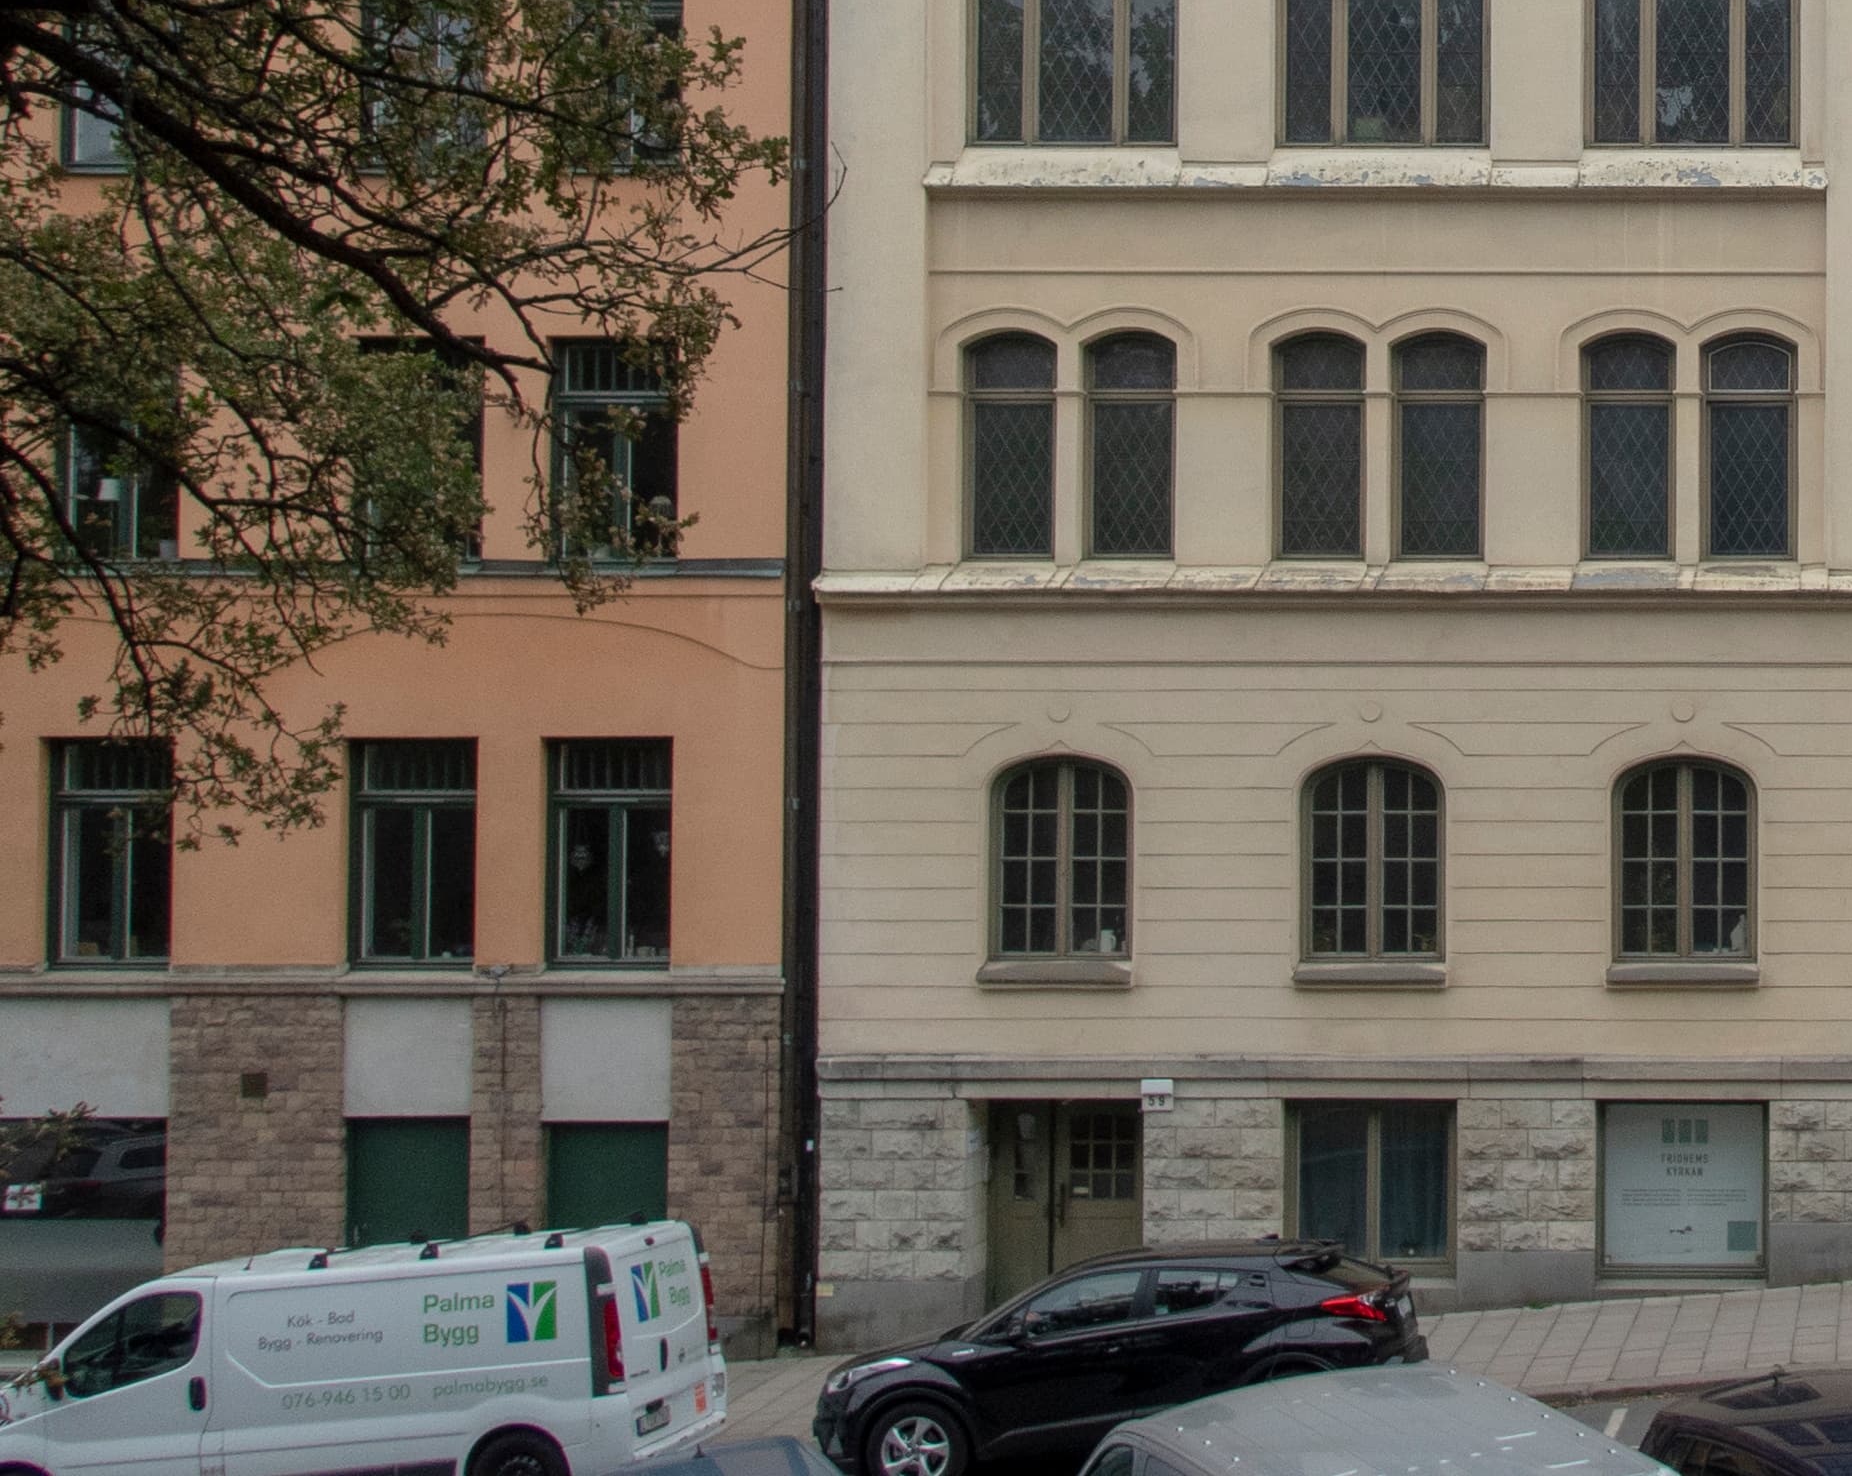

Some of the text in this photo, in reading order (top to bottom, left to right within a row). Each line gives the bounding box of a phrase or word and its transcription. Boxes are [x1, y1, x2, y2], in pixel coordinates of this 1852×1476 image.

[423, 1291, 495, 1314] Palma
[327, 1309, 355, 1325] Bad
[257, 1335, 292, 1351] Bygg
[306, 1327, 384, 1345] Renovering
[423, 1323, 480, 1347] Bygg
[388, 1383, 411, 1401] 00
[432, 1374, 549, 1400] palmabygg.se
